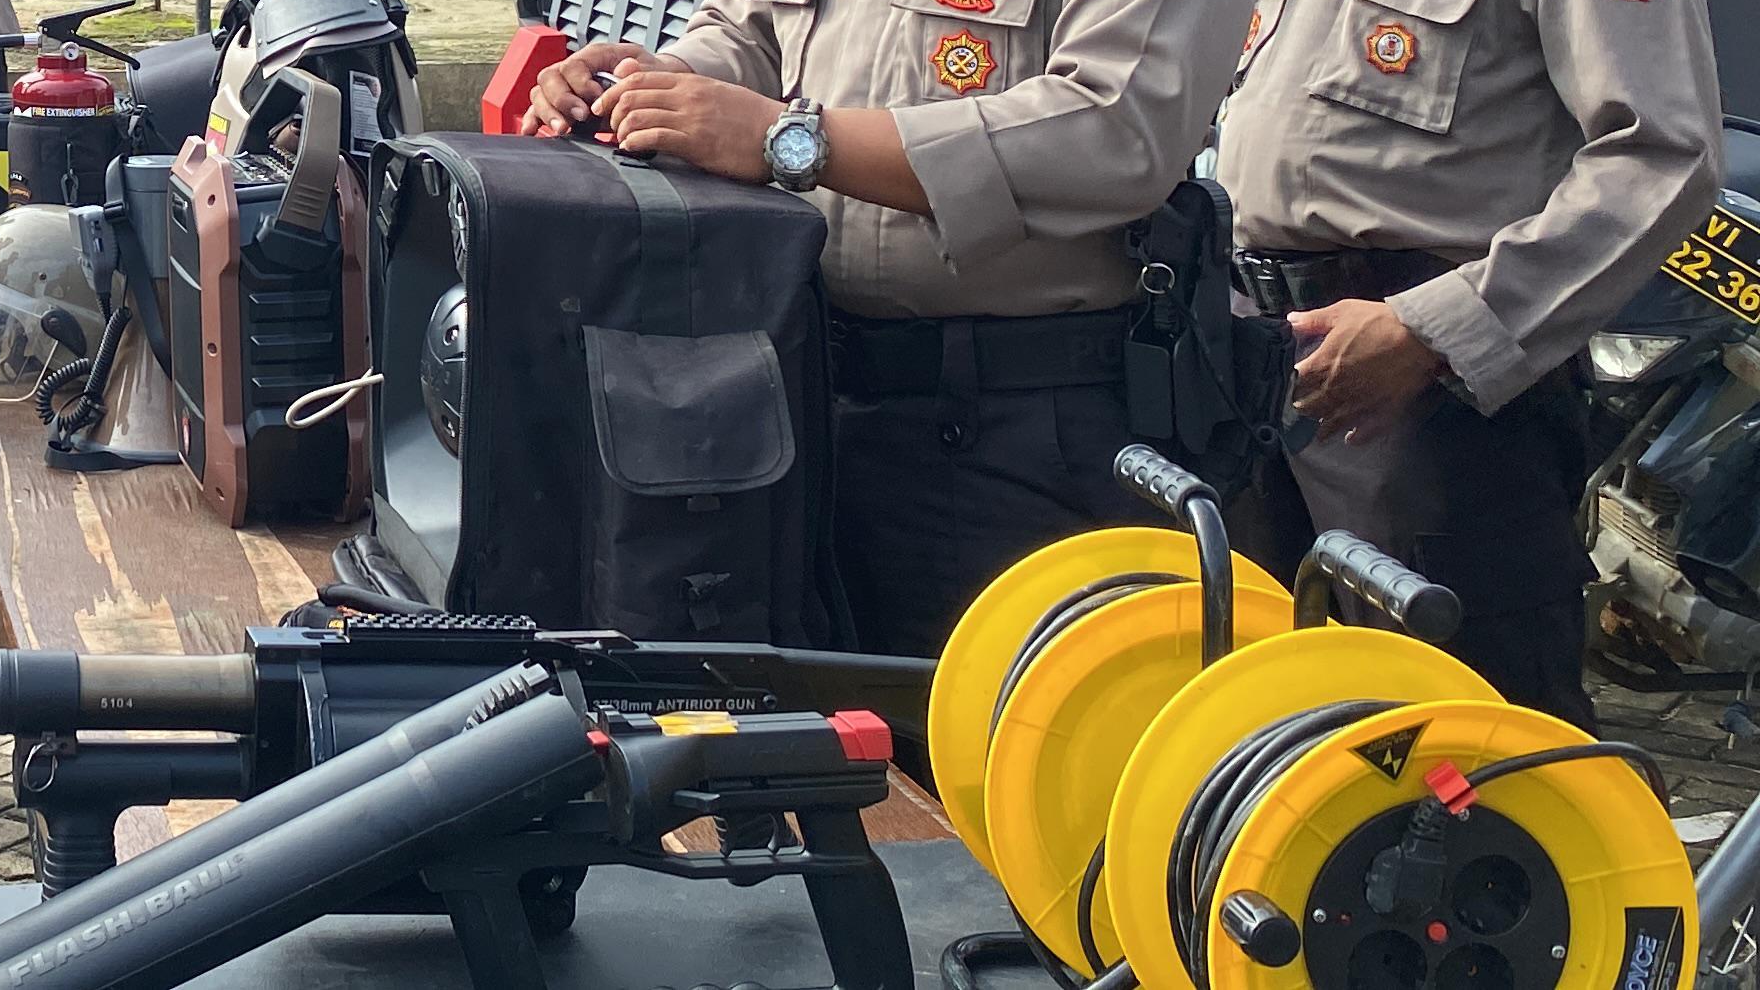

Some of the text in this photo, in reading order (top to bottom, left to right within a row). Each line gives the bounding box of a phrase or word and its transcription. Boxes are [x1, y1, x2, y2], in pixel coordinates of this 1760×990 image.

[46, 107, 95, 117] EXTINGUISHER
[656, 698, 723, 711] ANTIRIOT
[726, 698, 756, 711] GUN
